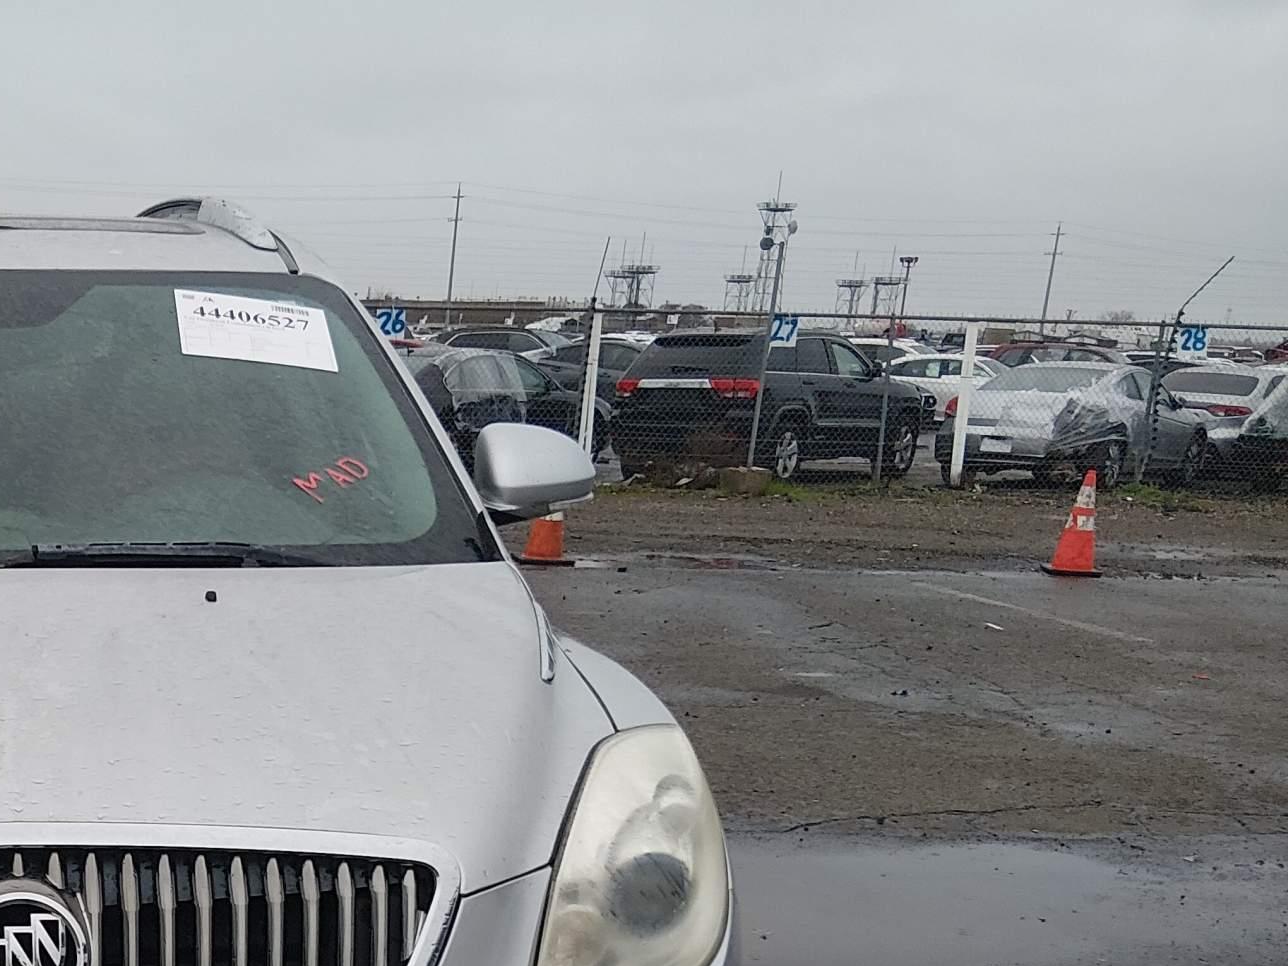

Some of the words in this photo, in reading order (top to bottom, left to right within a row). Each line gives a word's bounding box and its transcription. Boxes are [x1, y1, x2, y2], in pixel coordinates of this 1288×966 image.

[193, 305, 309, 331] 44406527
[376, 309, 405, 335] 26
[770, 315, 799, 342] 27
[1180, 328, 1207, 351] 28
